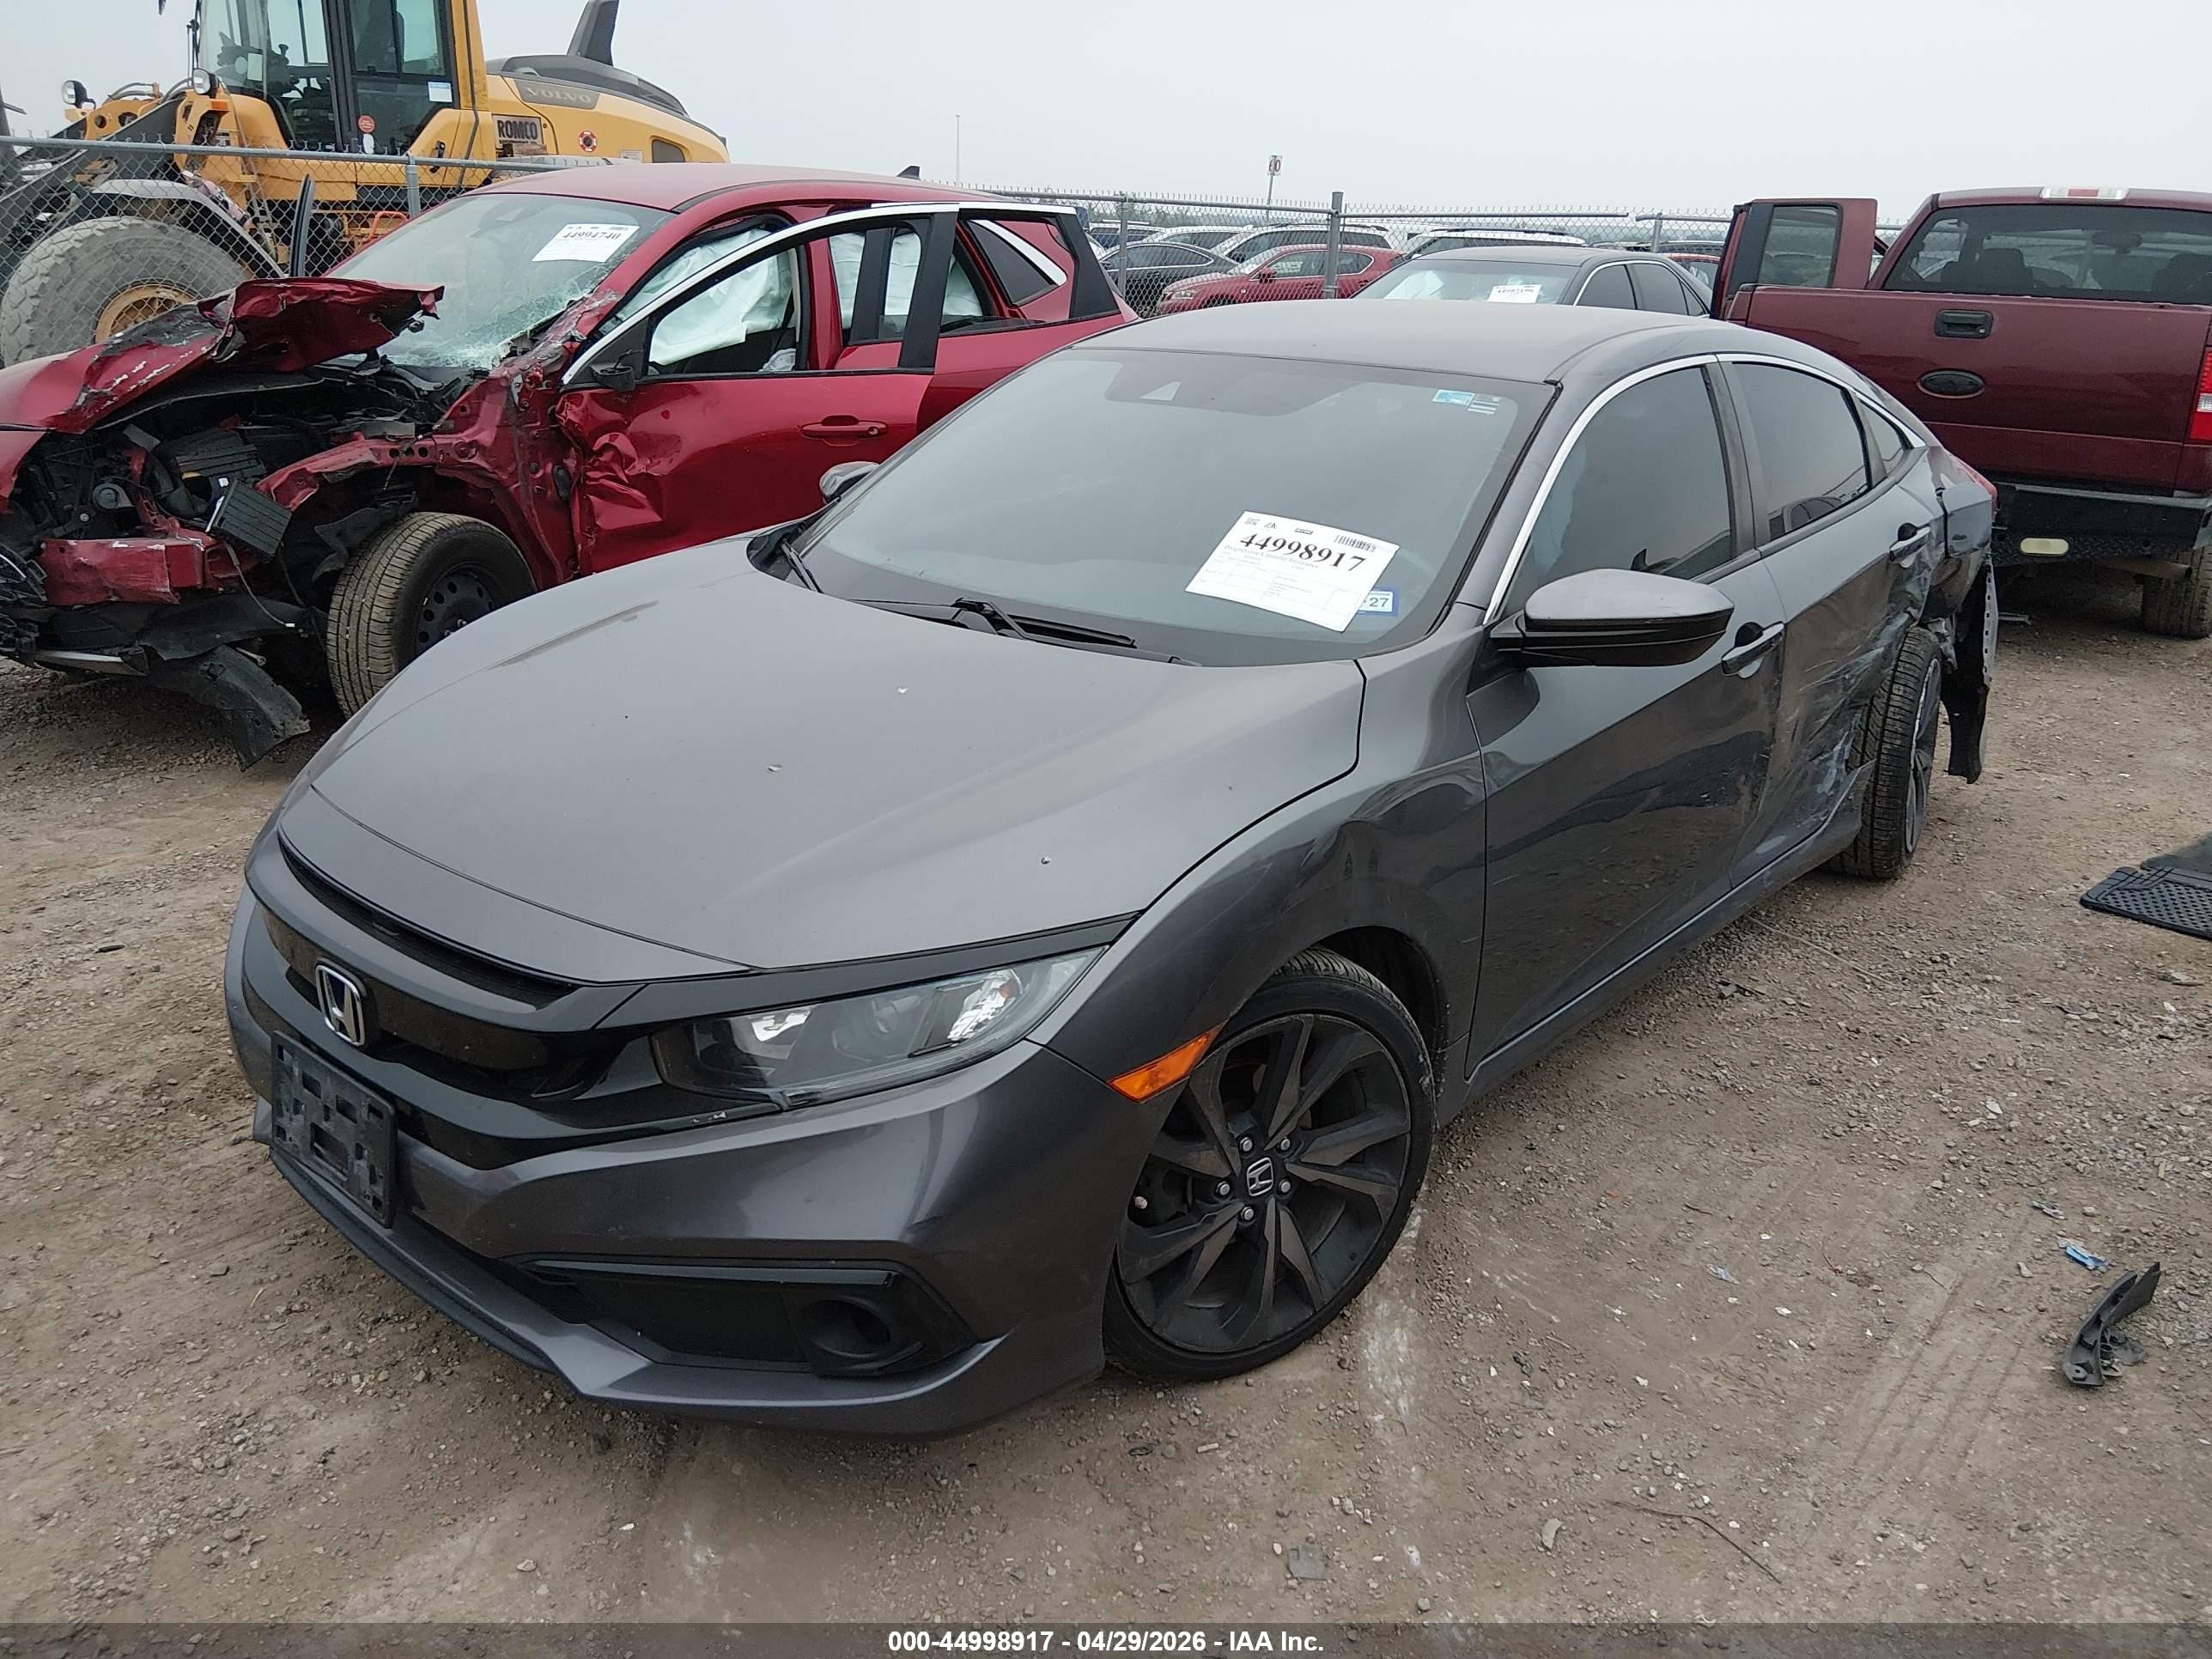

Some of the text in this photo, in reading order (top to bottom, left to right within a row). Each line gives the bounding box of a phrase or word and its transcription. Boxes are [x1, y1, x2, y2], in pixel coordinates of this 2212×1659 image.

[526, 87, 592, 104] VOLVO
[496, 119, 538, 141] ROMCO
[1240, 533, 1367, 572] 44998917
